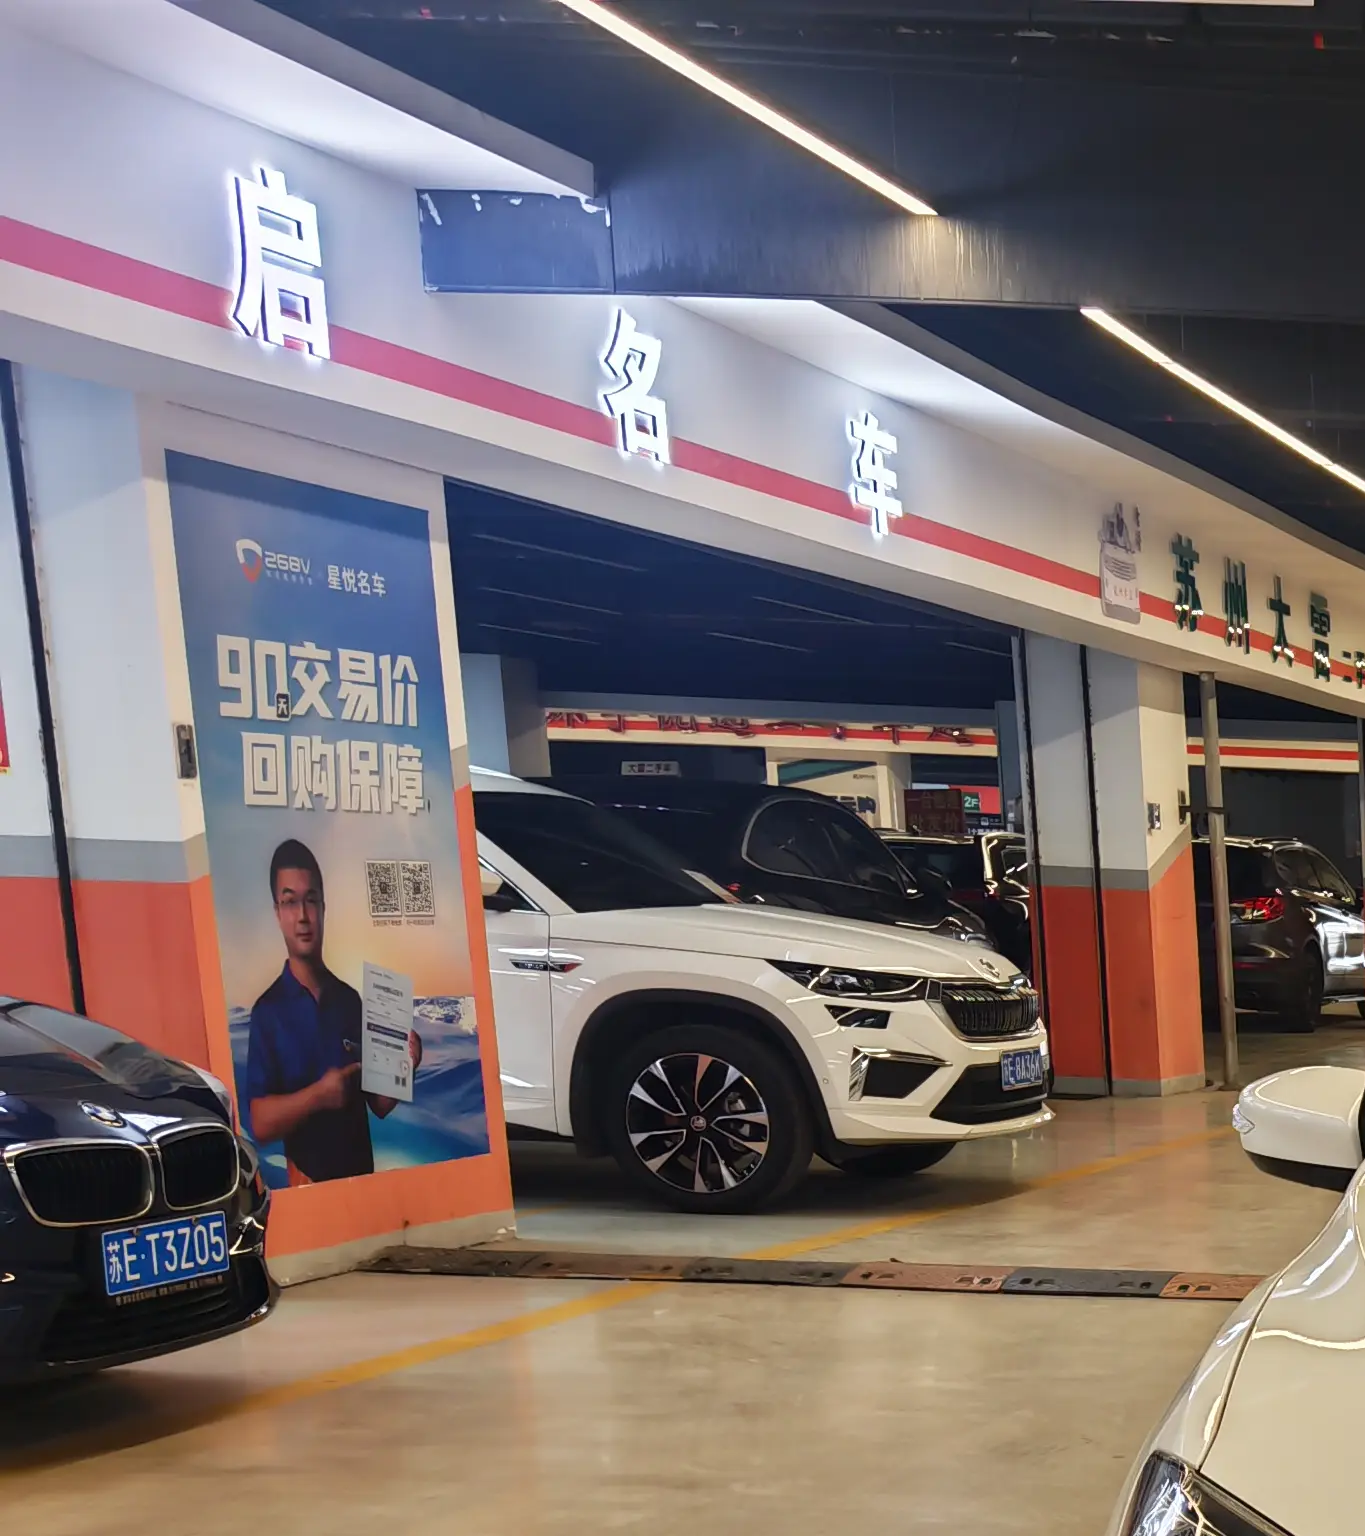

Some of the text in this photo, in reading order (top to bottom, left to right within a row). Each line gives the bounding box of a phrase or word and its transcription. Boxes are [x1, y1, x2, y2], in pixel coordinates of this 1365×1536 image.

[327, 564, 387, 598] 星悦名车
[241, 731, 425, 816] 回购保障
[963, 795, 978, 808] 2F
